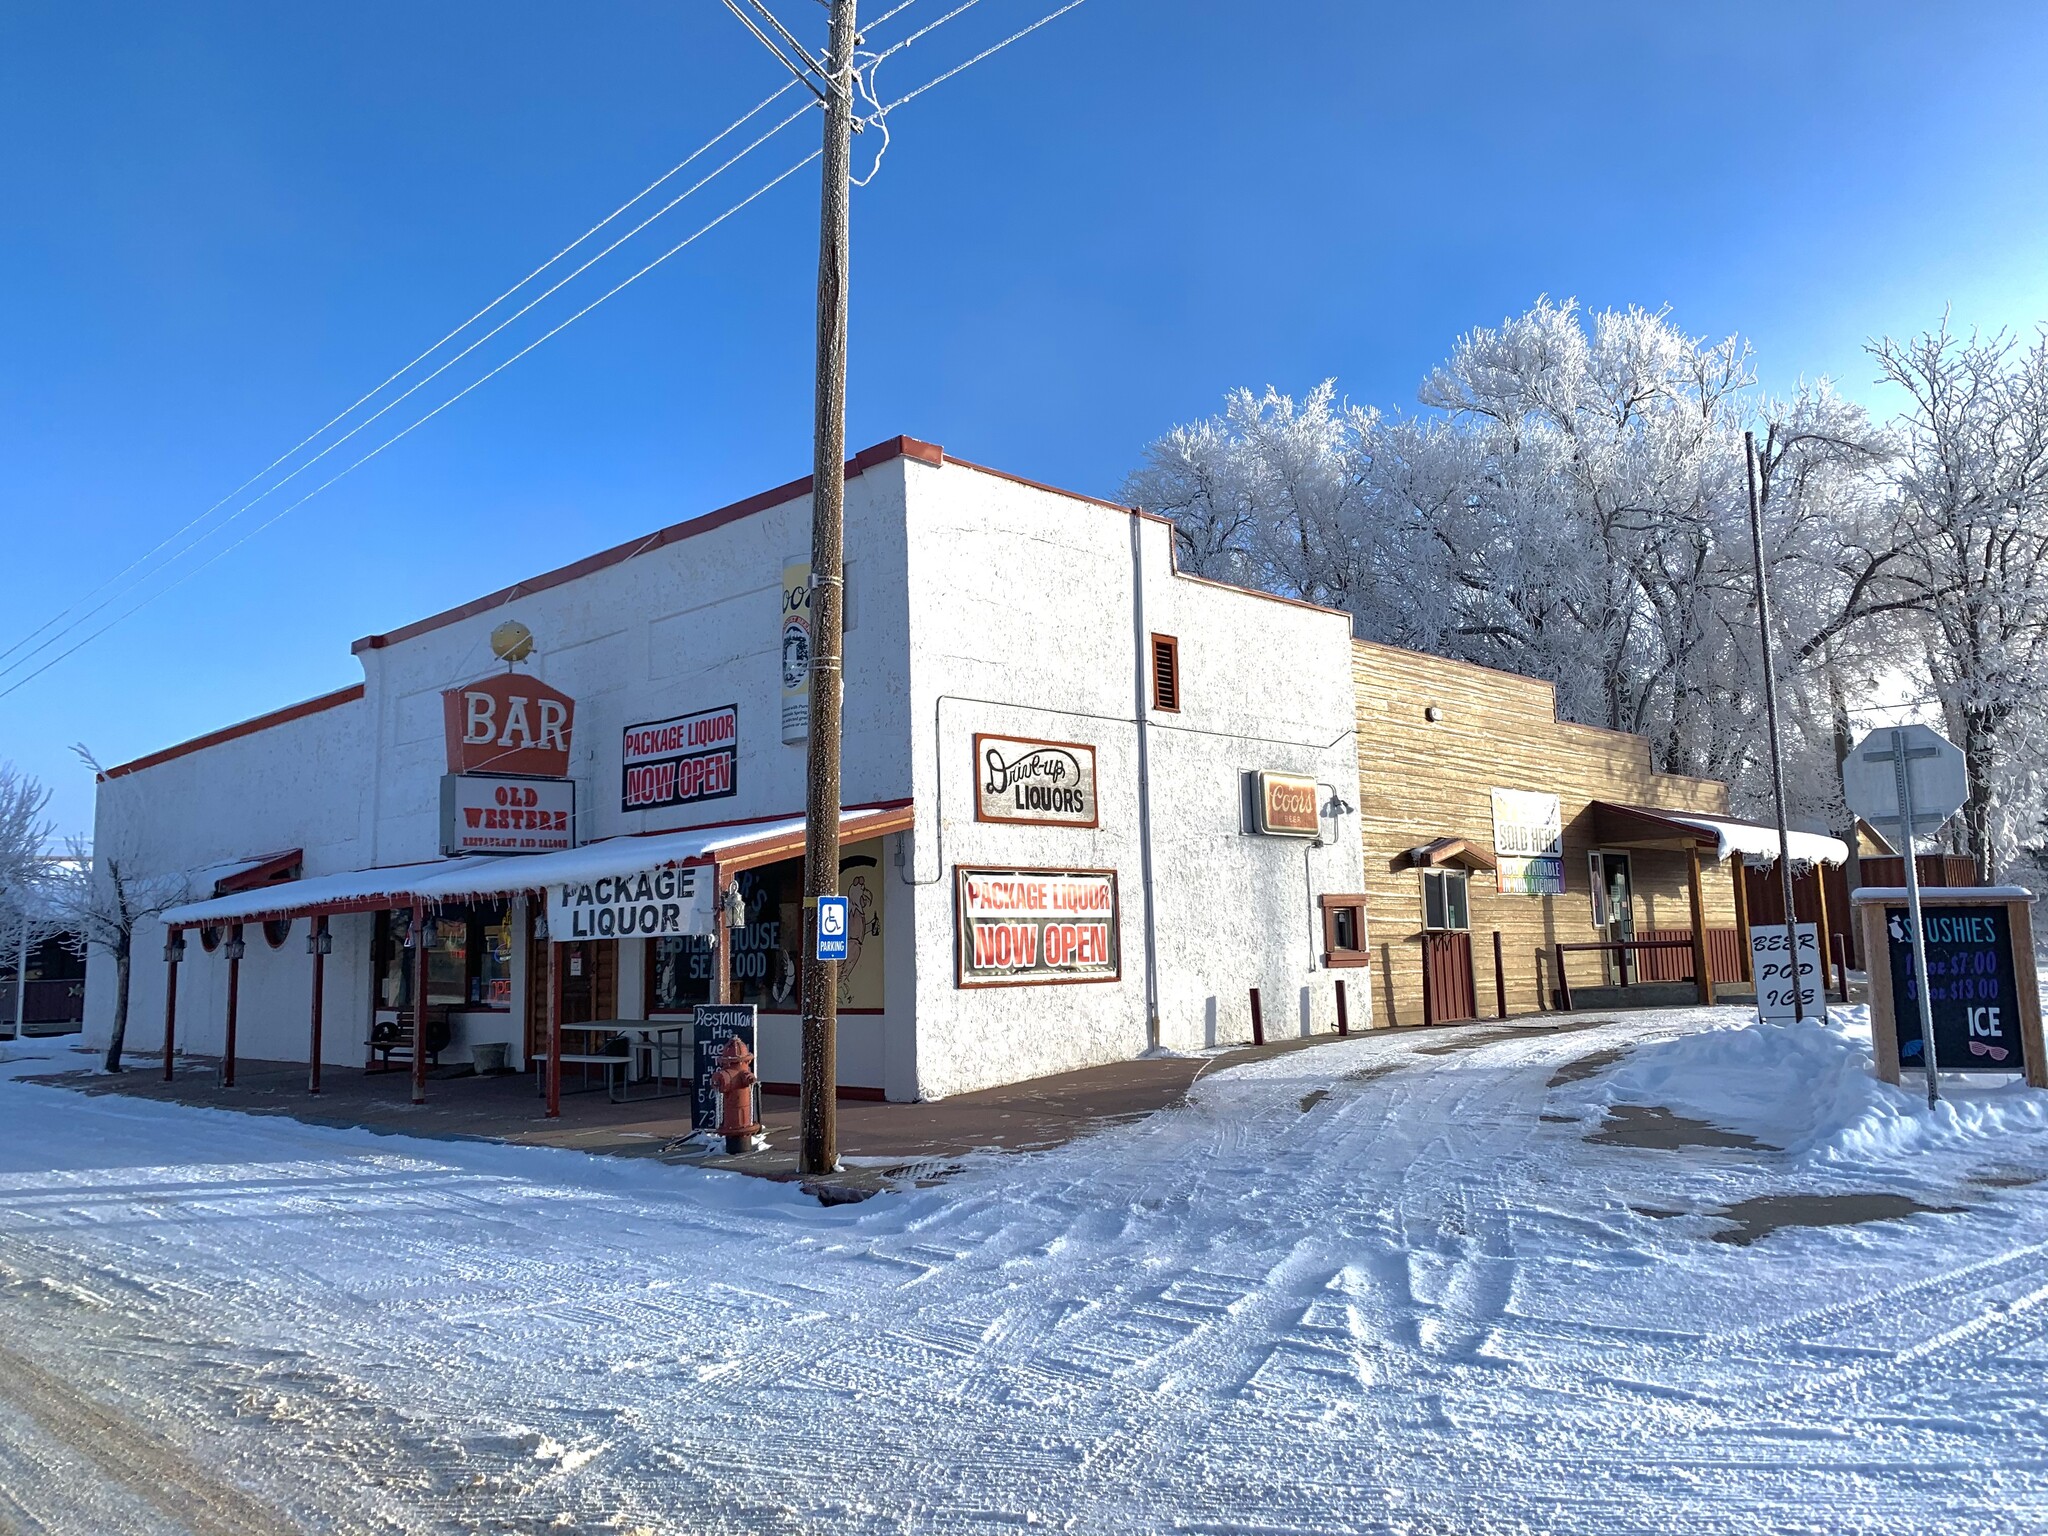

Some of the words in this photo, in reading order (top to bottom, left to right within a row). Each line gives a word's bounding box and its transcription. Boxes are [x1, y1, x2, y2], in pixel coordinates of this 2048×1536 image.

[463, 691, 568, 752] BAR
[625, 725, 684, 757] PACKAGE
[687, 714, 735, 748] LIQUOR
[627, 762, 676, 806] NOW
[679, 751, 731, 799] OPEN
[494, 786, 539, 808] OLD
[1014, 784, 1085, 813] LIQUORS
[1270, 785, 1313, 814] Coors
[463, 807, 568, 831] WESTERN
[1284, 815, 1301, 824] BEER
[462, 837, 517, 848] RESTAURANT
[519, 838, 537, 848] AND
[538, 838, 568, 849] SALOON
[1500, 825, 1528, 852] SOLD
[1531, 828, 1559, 853] HERE
[1523, 861, 1560, 877] AVAILABLE
[561, 869, 696, 907] PACKAGE
[968, 881, 1048, 910] PACKAGE
[1053, 883, 1111, 914] LIQUOR
[1503, 878, 1511, 892] IN
[1513, 877, 1529, 892] NON
[1531, 878, 1562, 893] ALCOHOL
[572, 903, 681, 937] LIQUOR
[1903, 917, 1997, 943] SUSHIES
[820, 940, 845, 952] PARKING
[974, 924, 1038, 968] NOW
[1044, 923, 1109, 967] OPEN
[1753, 933, 1816, 951] BEER
[1762, 963, 1814, 981] POP
[1951, 951, 1998, 976] $7.00
[1767, 988, 1815, 1007] ICE
[1967, 1006, 2003, 1037] ICE
